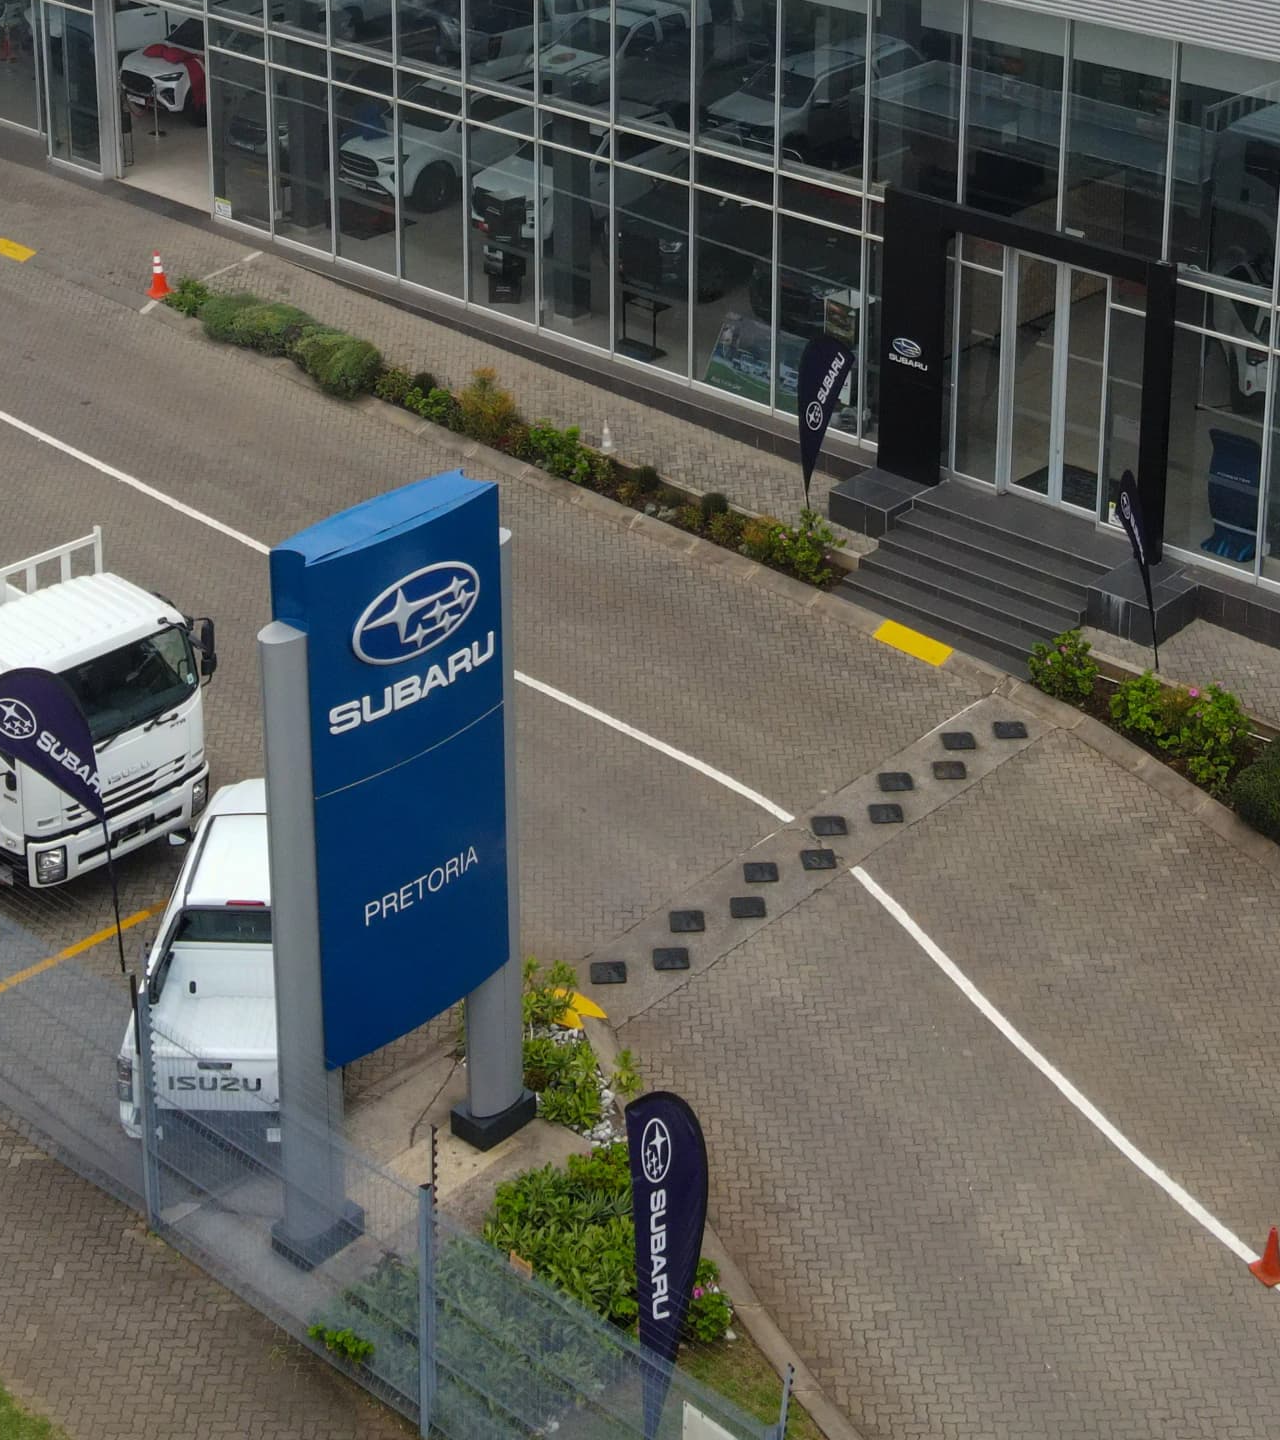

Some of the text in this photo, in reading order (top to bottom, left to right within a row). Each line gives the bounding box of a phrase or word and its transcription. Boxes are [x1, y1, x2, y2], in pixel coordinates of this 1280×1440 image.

[816, 351, 845, 405] SUBARU
[888, 352, 929, 372] SUBARU
[328, 630, 496, 736] SUBARU
[36, 729, 103, 798] SUBAR
[363, 846, 480, 927] PRETORIA
[168, 1075, 262, 1092] ISUZU
[649, 1188, 671, 1321] SUBARU
